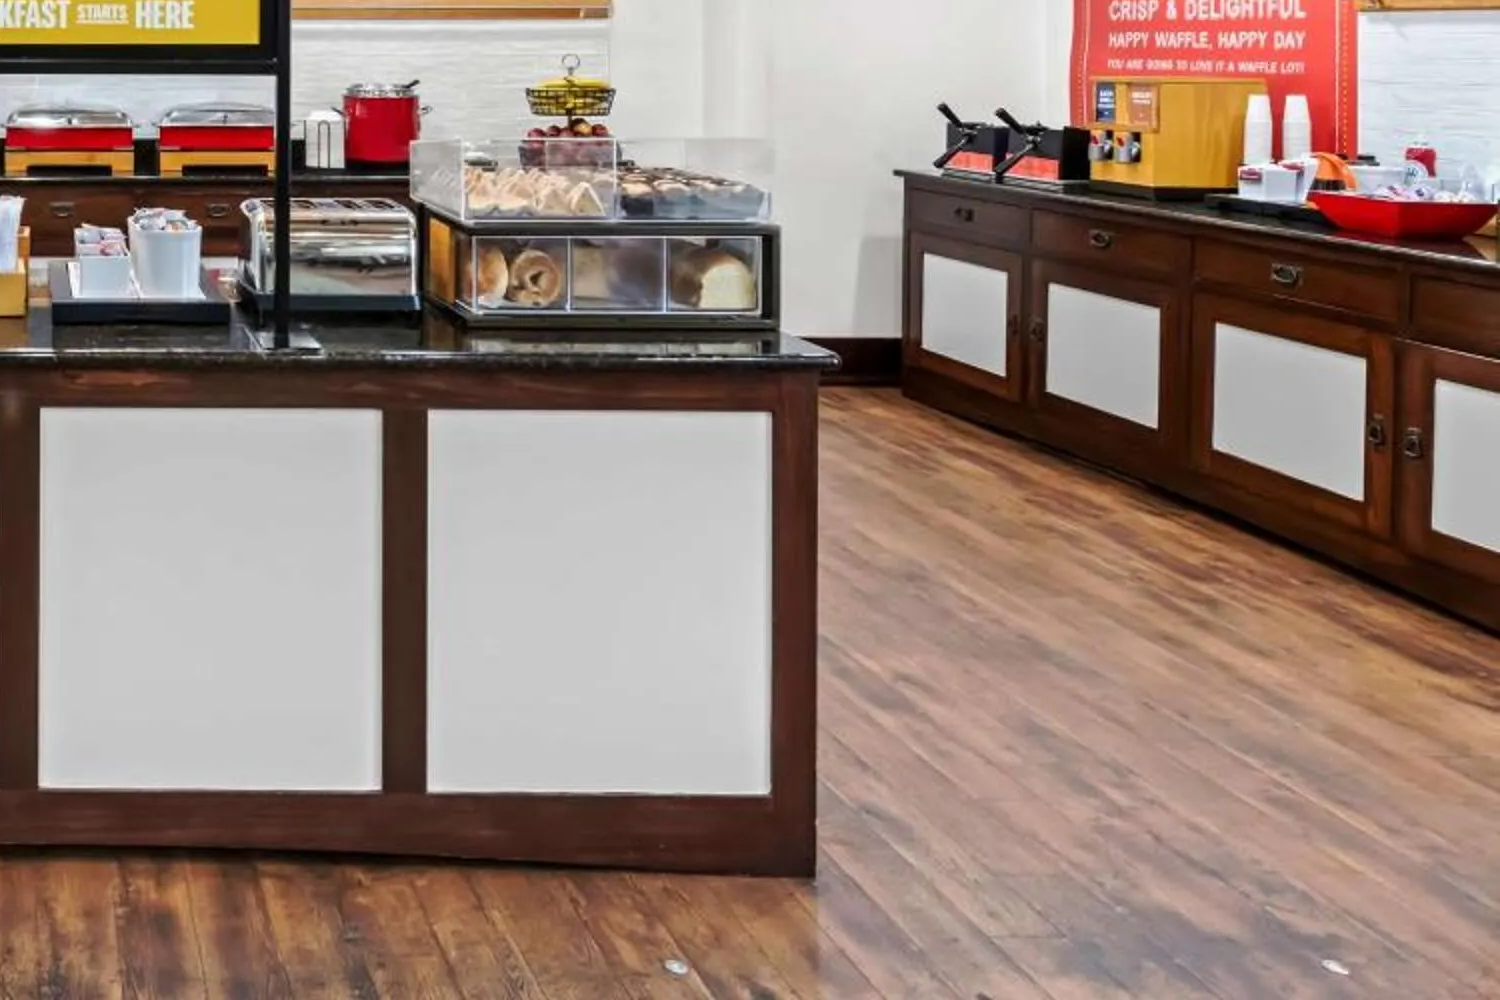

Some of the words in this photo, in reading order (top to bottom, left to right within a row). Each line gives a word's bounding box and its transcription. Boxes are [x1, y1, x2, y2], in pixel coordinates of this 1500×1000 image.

[77, 3, 128, 21] STARTS
[134, 0, 196, 30] HERE
[1108, 30, 1149, 49] HAPPY
[1155, 30, 1213, 50] WAFFLE,
[1217, 30, 1268, 49] HAPPY
[1273, 30, 1307, 50] DAY
[1126, 58, 1144, 71] ARE
[1190, 60, 1213, 73] LOVE
[1215, 60, 1224, 73] IT
[1227, 61, 1236, 73] A
[1238, 61, 1278, 74] WAFFLE
